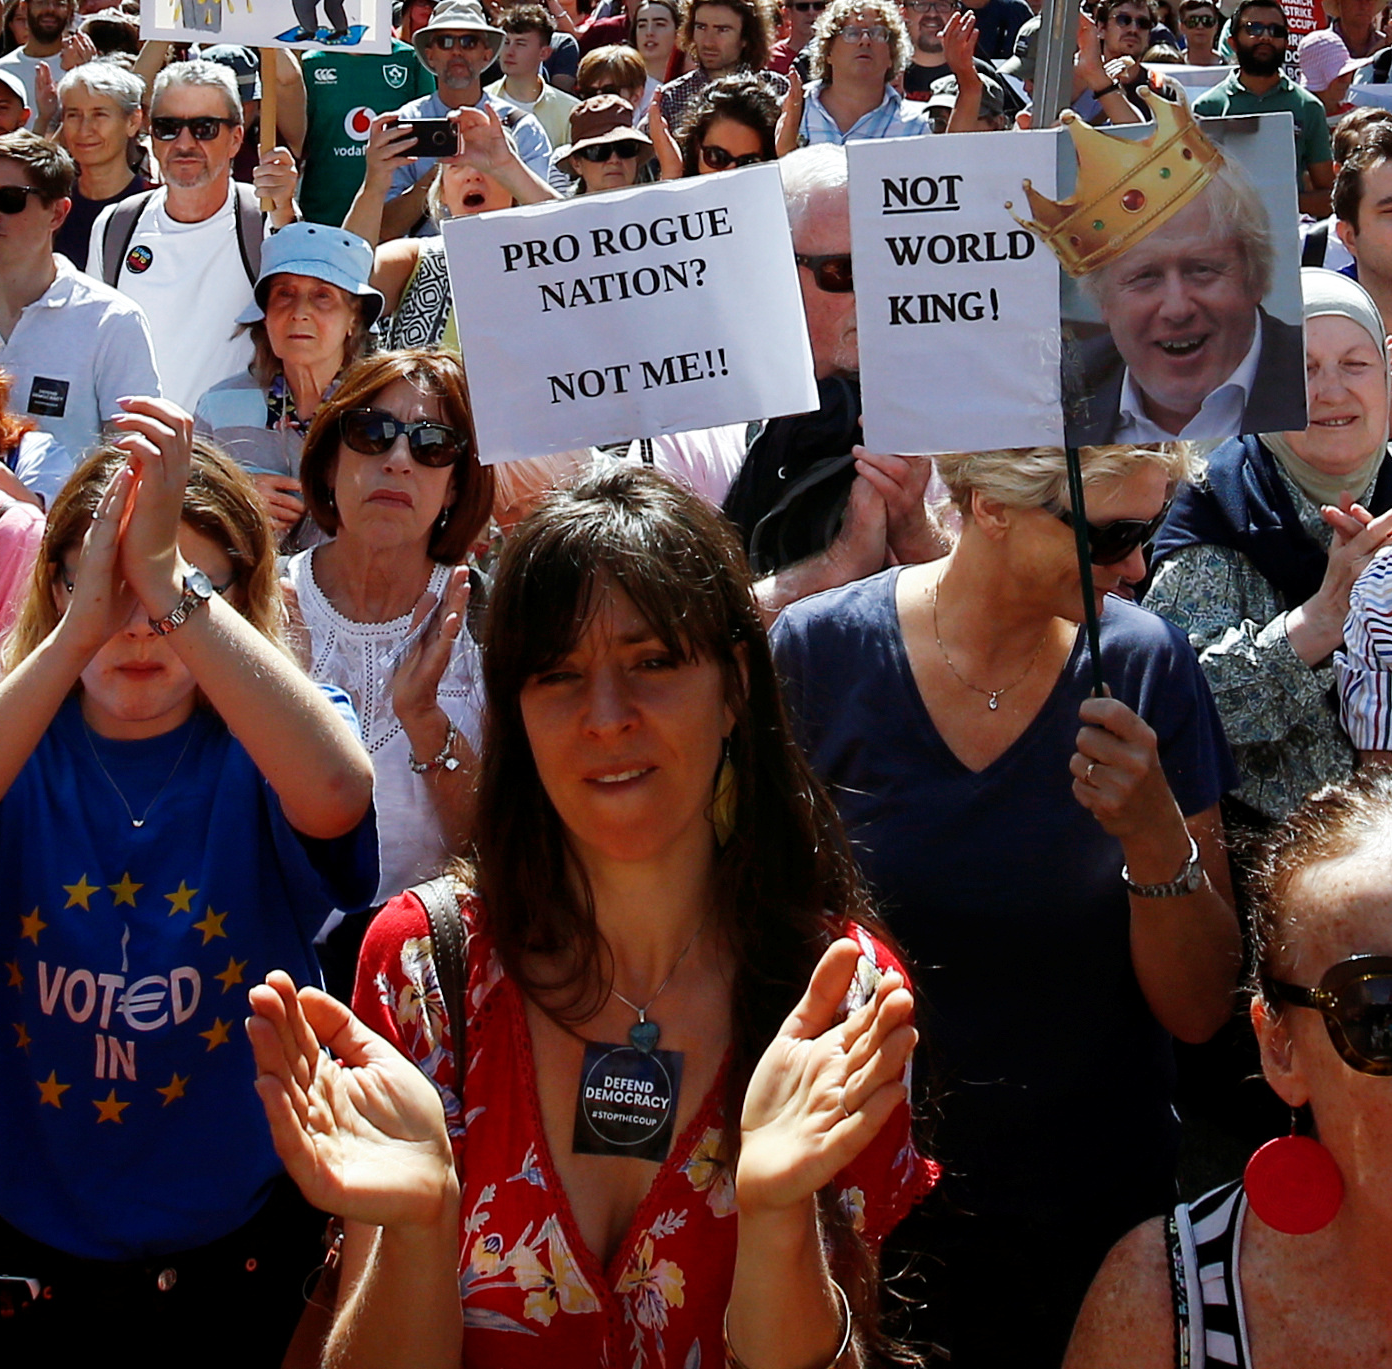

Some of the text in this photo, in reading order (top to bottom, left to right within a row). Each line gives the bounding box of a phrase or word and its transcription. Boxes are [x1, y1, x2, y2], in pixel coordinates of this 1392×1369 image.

[881, 175, 963, 208] NOT
[500, 207, 733, 273] PRO ROGUE
[885, 230, 1035, 266] WORLD
[538, 258, 707, 313] NATION?
[888, 288, 998, 324] KING!
[547, 347, 729, 404] NOT ME!!
[95, 1033, 137, 1081] IN
[585, 1086, 669, 1110] DEMOCRACY
[604, 1075, 654, 1093] DEFEND
[591, 1110, 657, 1127] #STOPTHECOUP
